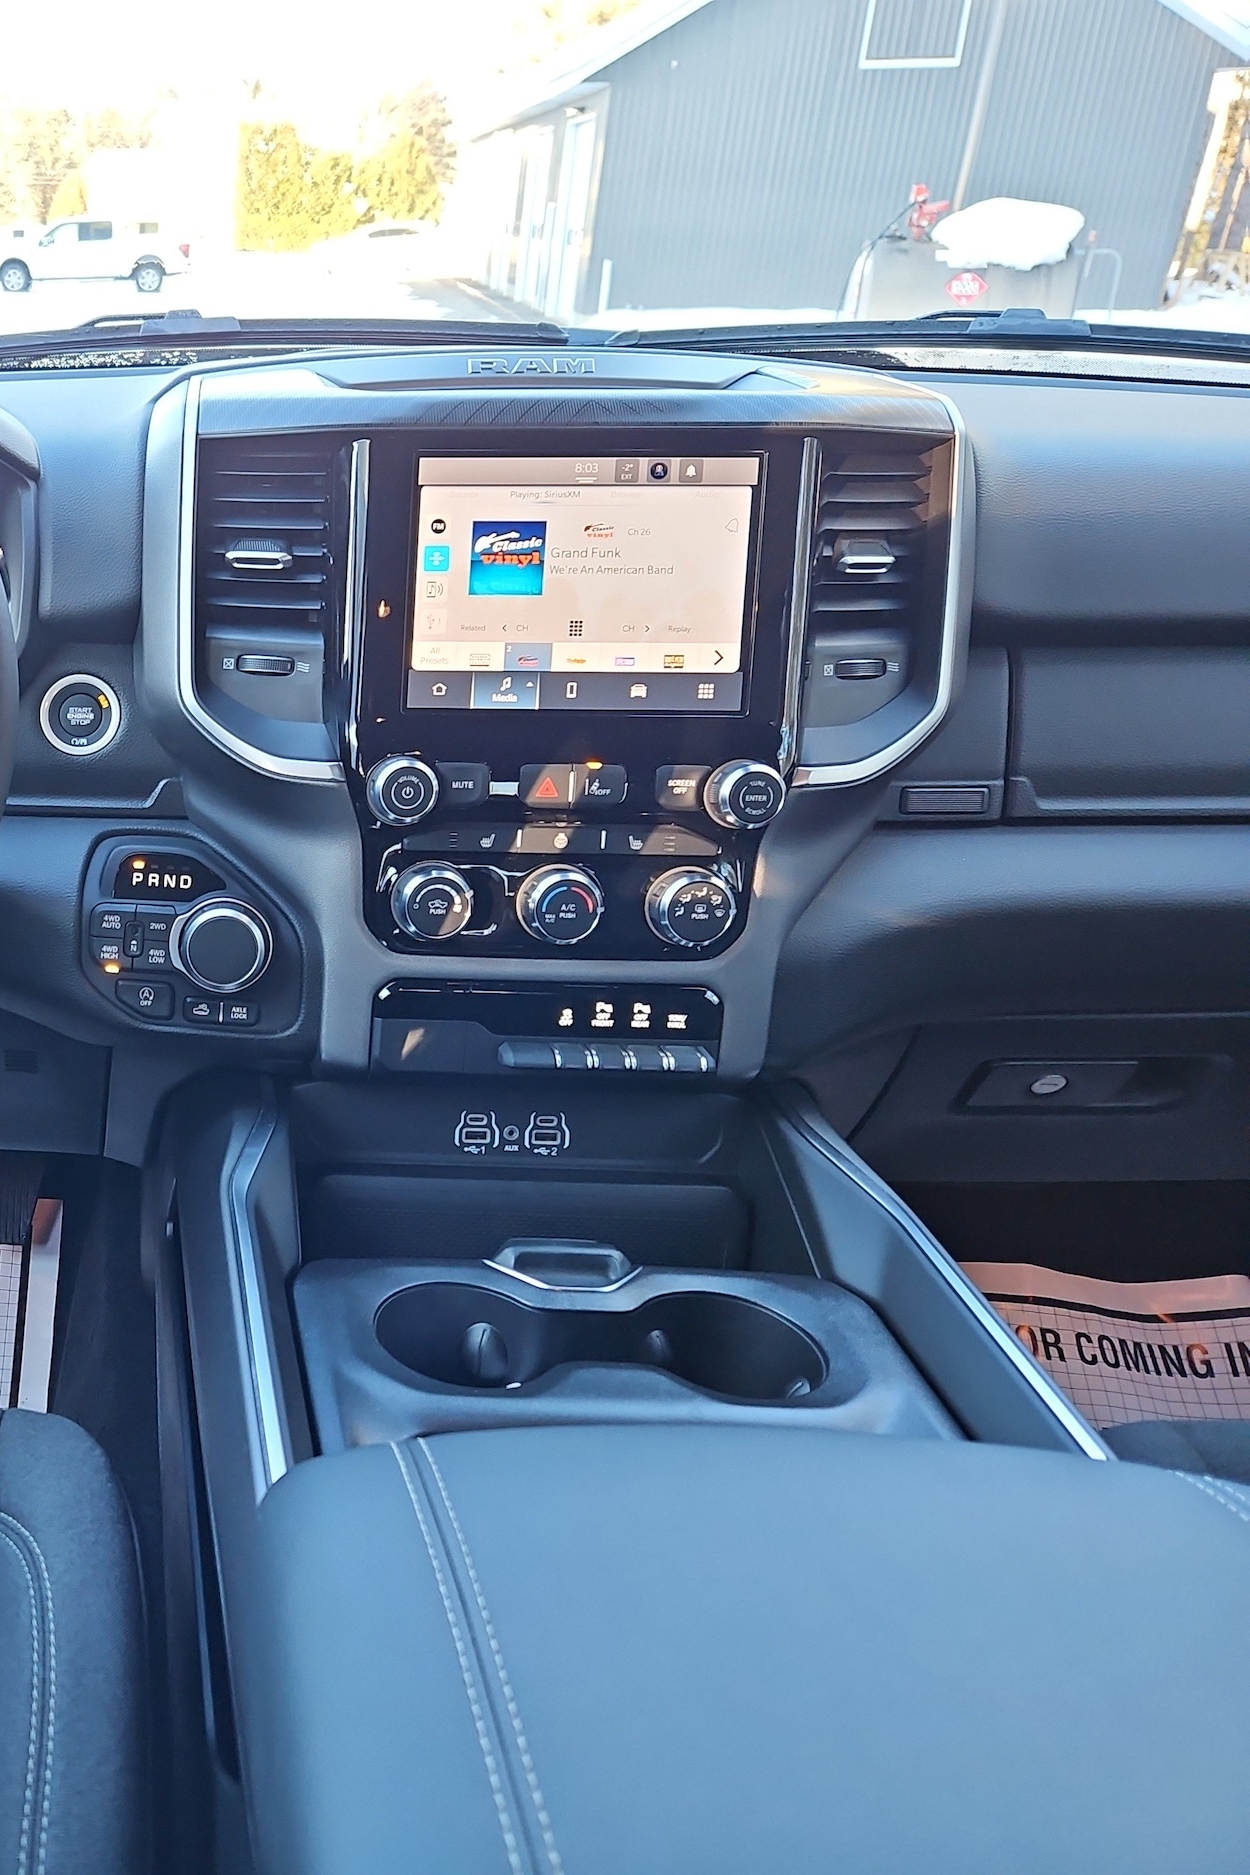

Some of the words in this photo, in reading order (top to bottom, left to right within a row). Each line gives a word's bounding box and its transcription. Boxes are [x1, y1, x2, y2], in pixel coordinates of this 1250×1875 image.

[467, 358, 595, 374] RAM
[575, 463, 598, 473] 8:03
[510, 490, 542, 500] Playing:
[544, 490, 581, 498] SiriusXM
[432, 523, 444, 531] FM
[627, 528, 639, 536] Ch
[640, 528, 651, 536] 26
[492, 536, 543, 552] Classic
[550, 547, 588, 559] Grand
[591, 547, 622, 559] Funk
[480, 552, 541, 568] vinyl
[549, 565, 579, 575] We're
[580, 565, 594, 575] An
[595, 565, 645, 575] American
[646, 565, 674, 575] Band
[668, 625, 692, 634] Replay
[491, 694, 518, 703] Media
[397, 775, 420, 784] VOLUME
[667, 779, 695, 787] SCREEN
[750, 780, 766, 788] TUNE
[452, 780, 474, 789] MUTE
[673, 787, 687, 795] OFF
[745, 807, 767, 816] SCROLL
[561, 903, 576, 911] A/C
[103, 914, 121, 922] 4WD
[150, 922, 167, 930] 2WD
[101, 945, 119, 953] 4WD
[130, 944, 137, 952] N
[100, 952, 119, 960] HIGH
[148, 949, 165, 957] 4WD
[551, 1147, 558, 1156] 2
[1015, 1324, 1066, 1363] OR
[1075, 1331, 1215, 1379] COMING
